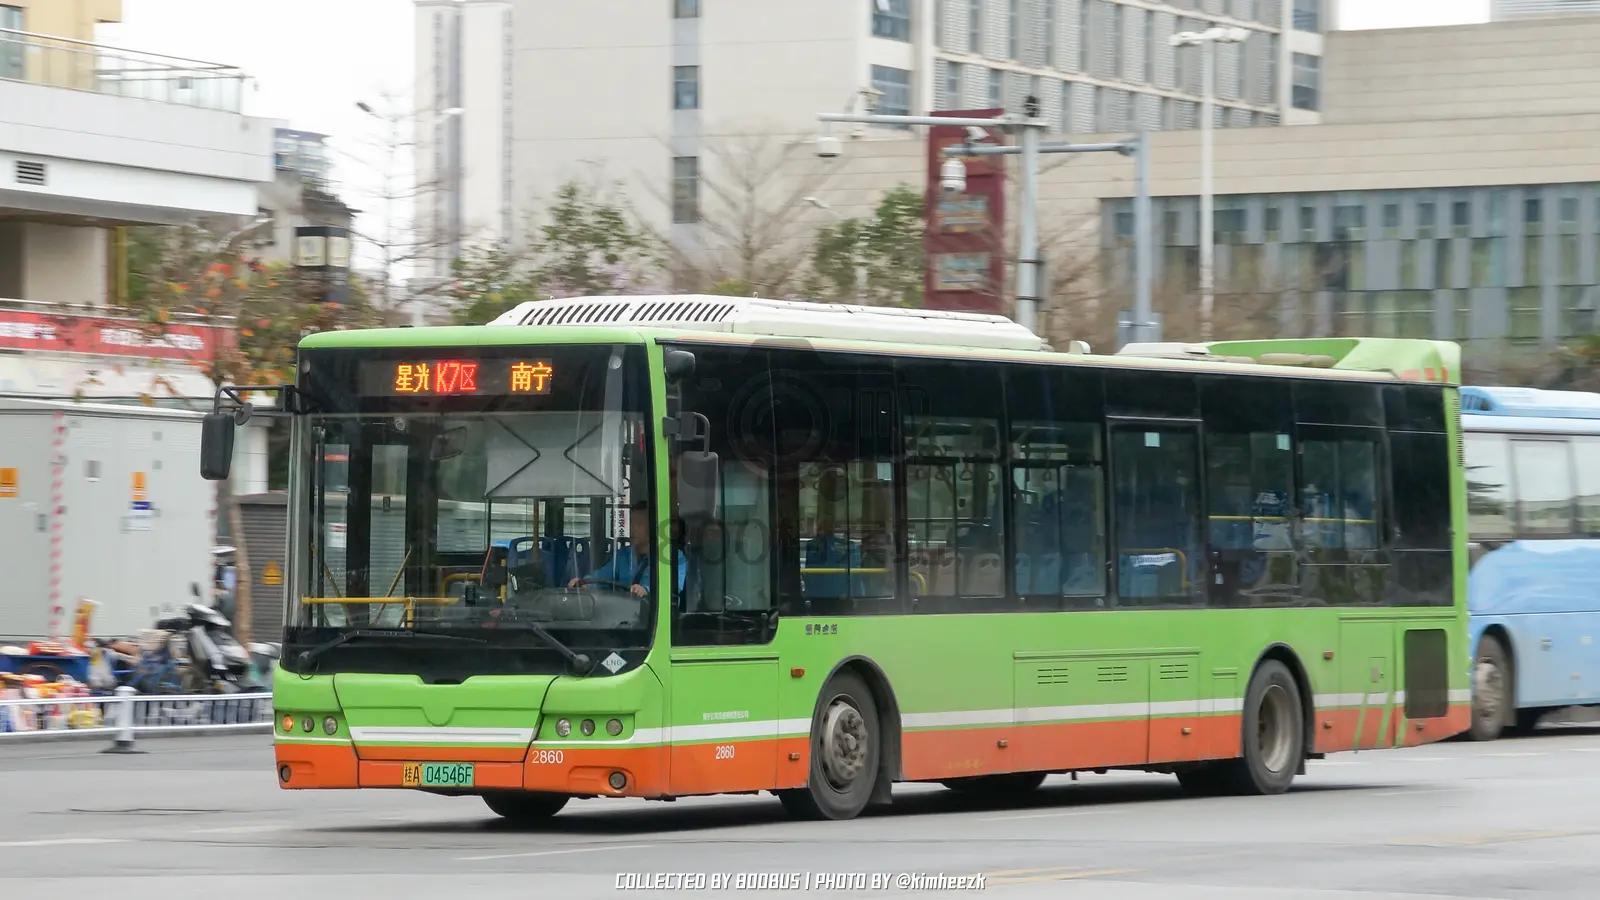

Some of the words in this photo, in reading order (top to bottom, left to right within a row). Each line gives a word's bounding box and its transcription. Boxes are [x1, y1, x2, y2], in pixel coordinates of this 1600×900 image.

[511, 361, 553, 392] 南宁
[606, 658, 624, 667] LNG
[531, 750, 564, 764] 2860
[715, 745, 735, 760] 2860
